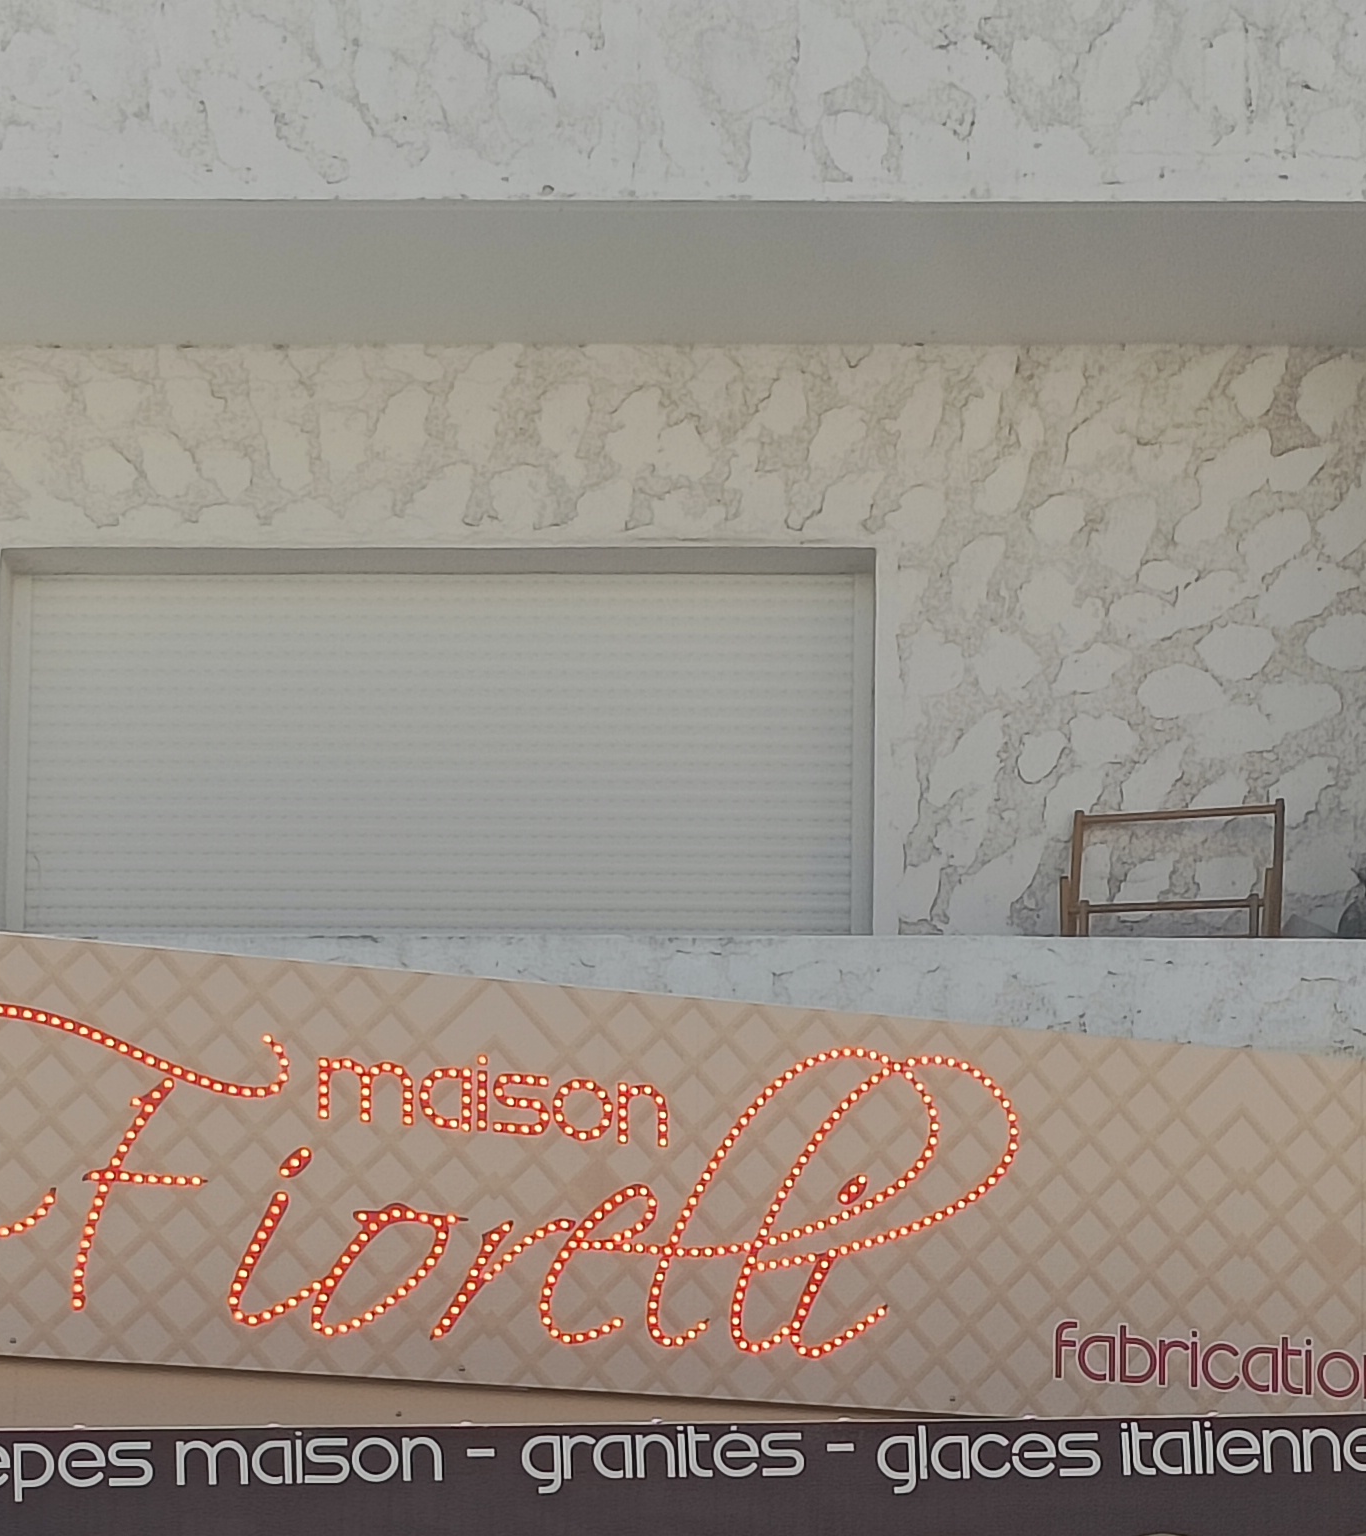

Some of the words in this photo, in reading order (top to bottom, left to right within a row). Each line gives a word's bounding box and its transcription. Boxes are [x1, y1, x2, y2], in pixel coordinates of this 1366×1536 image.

[317, 1054, 670, 1148] maison
[175, 1429, 443, 1487] maison
[519, 1423, 806, 1496] granités
[876, 1421, 1102, 1496] glaces
